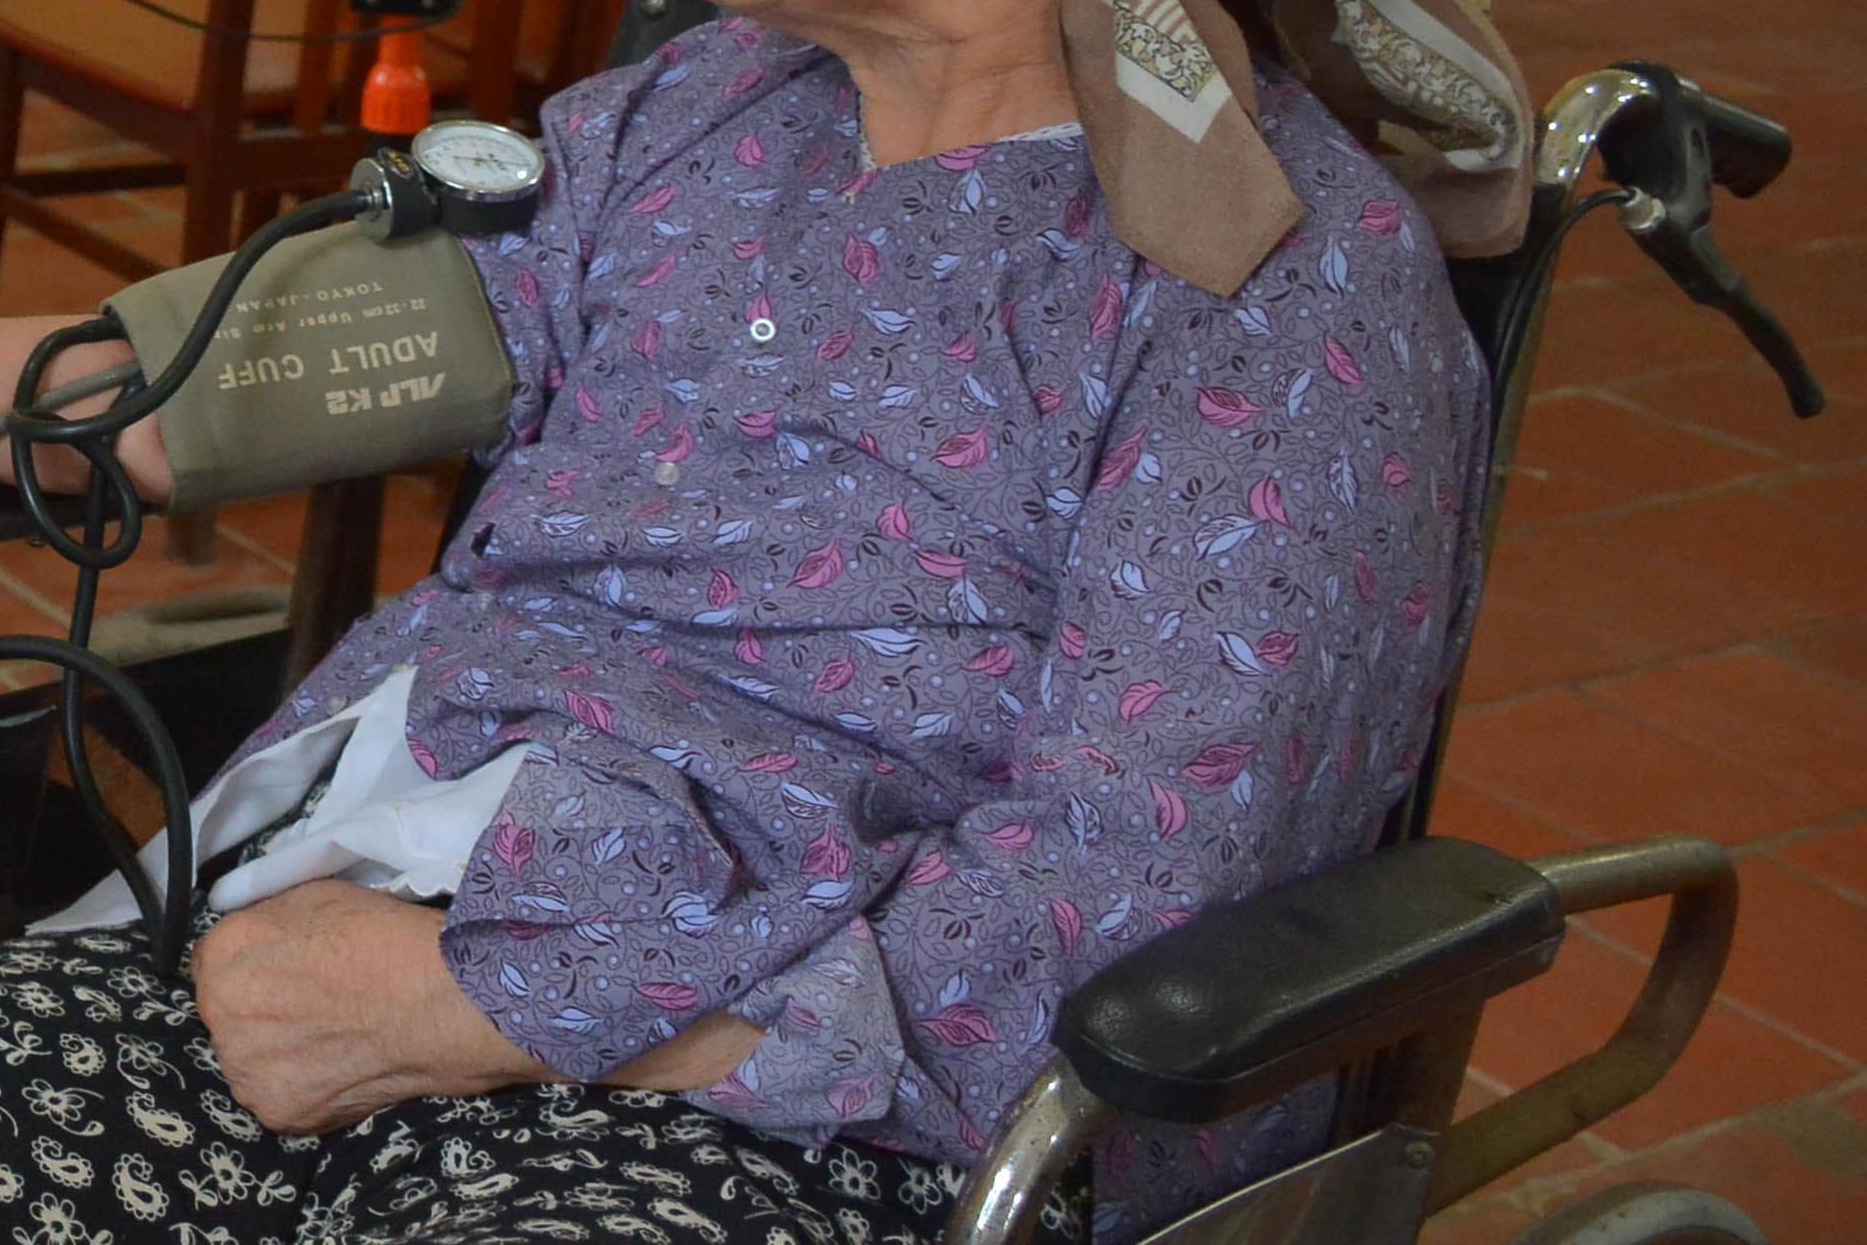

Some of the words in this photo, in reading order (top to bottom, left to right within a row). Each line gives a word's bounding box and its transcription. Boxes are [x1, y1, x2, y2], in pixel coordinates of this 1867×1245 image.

[316, 281, 384, 301] TOKYO
[235, 293, 300, 313] JAPAN
[252, 320, 286, 334] Arm
[299, 311, 352, 328] Upper
[329, 331, 439, 374] ADULT
[218, 354, 305, 390] CUFF
